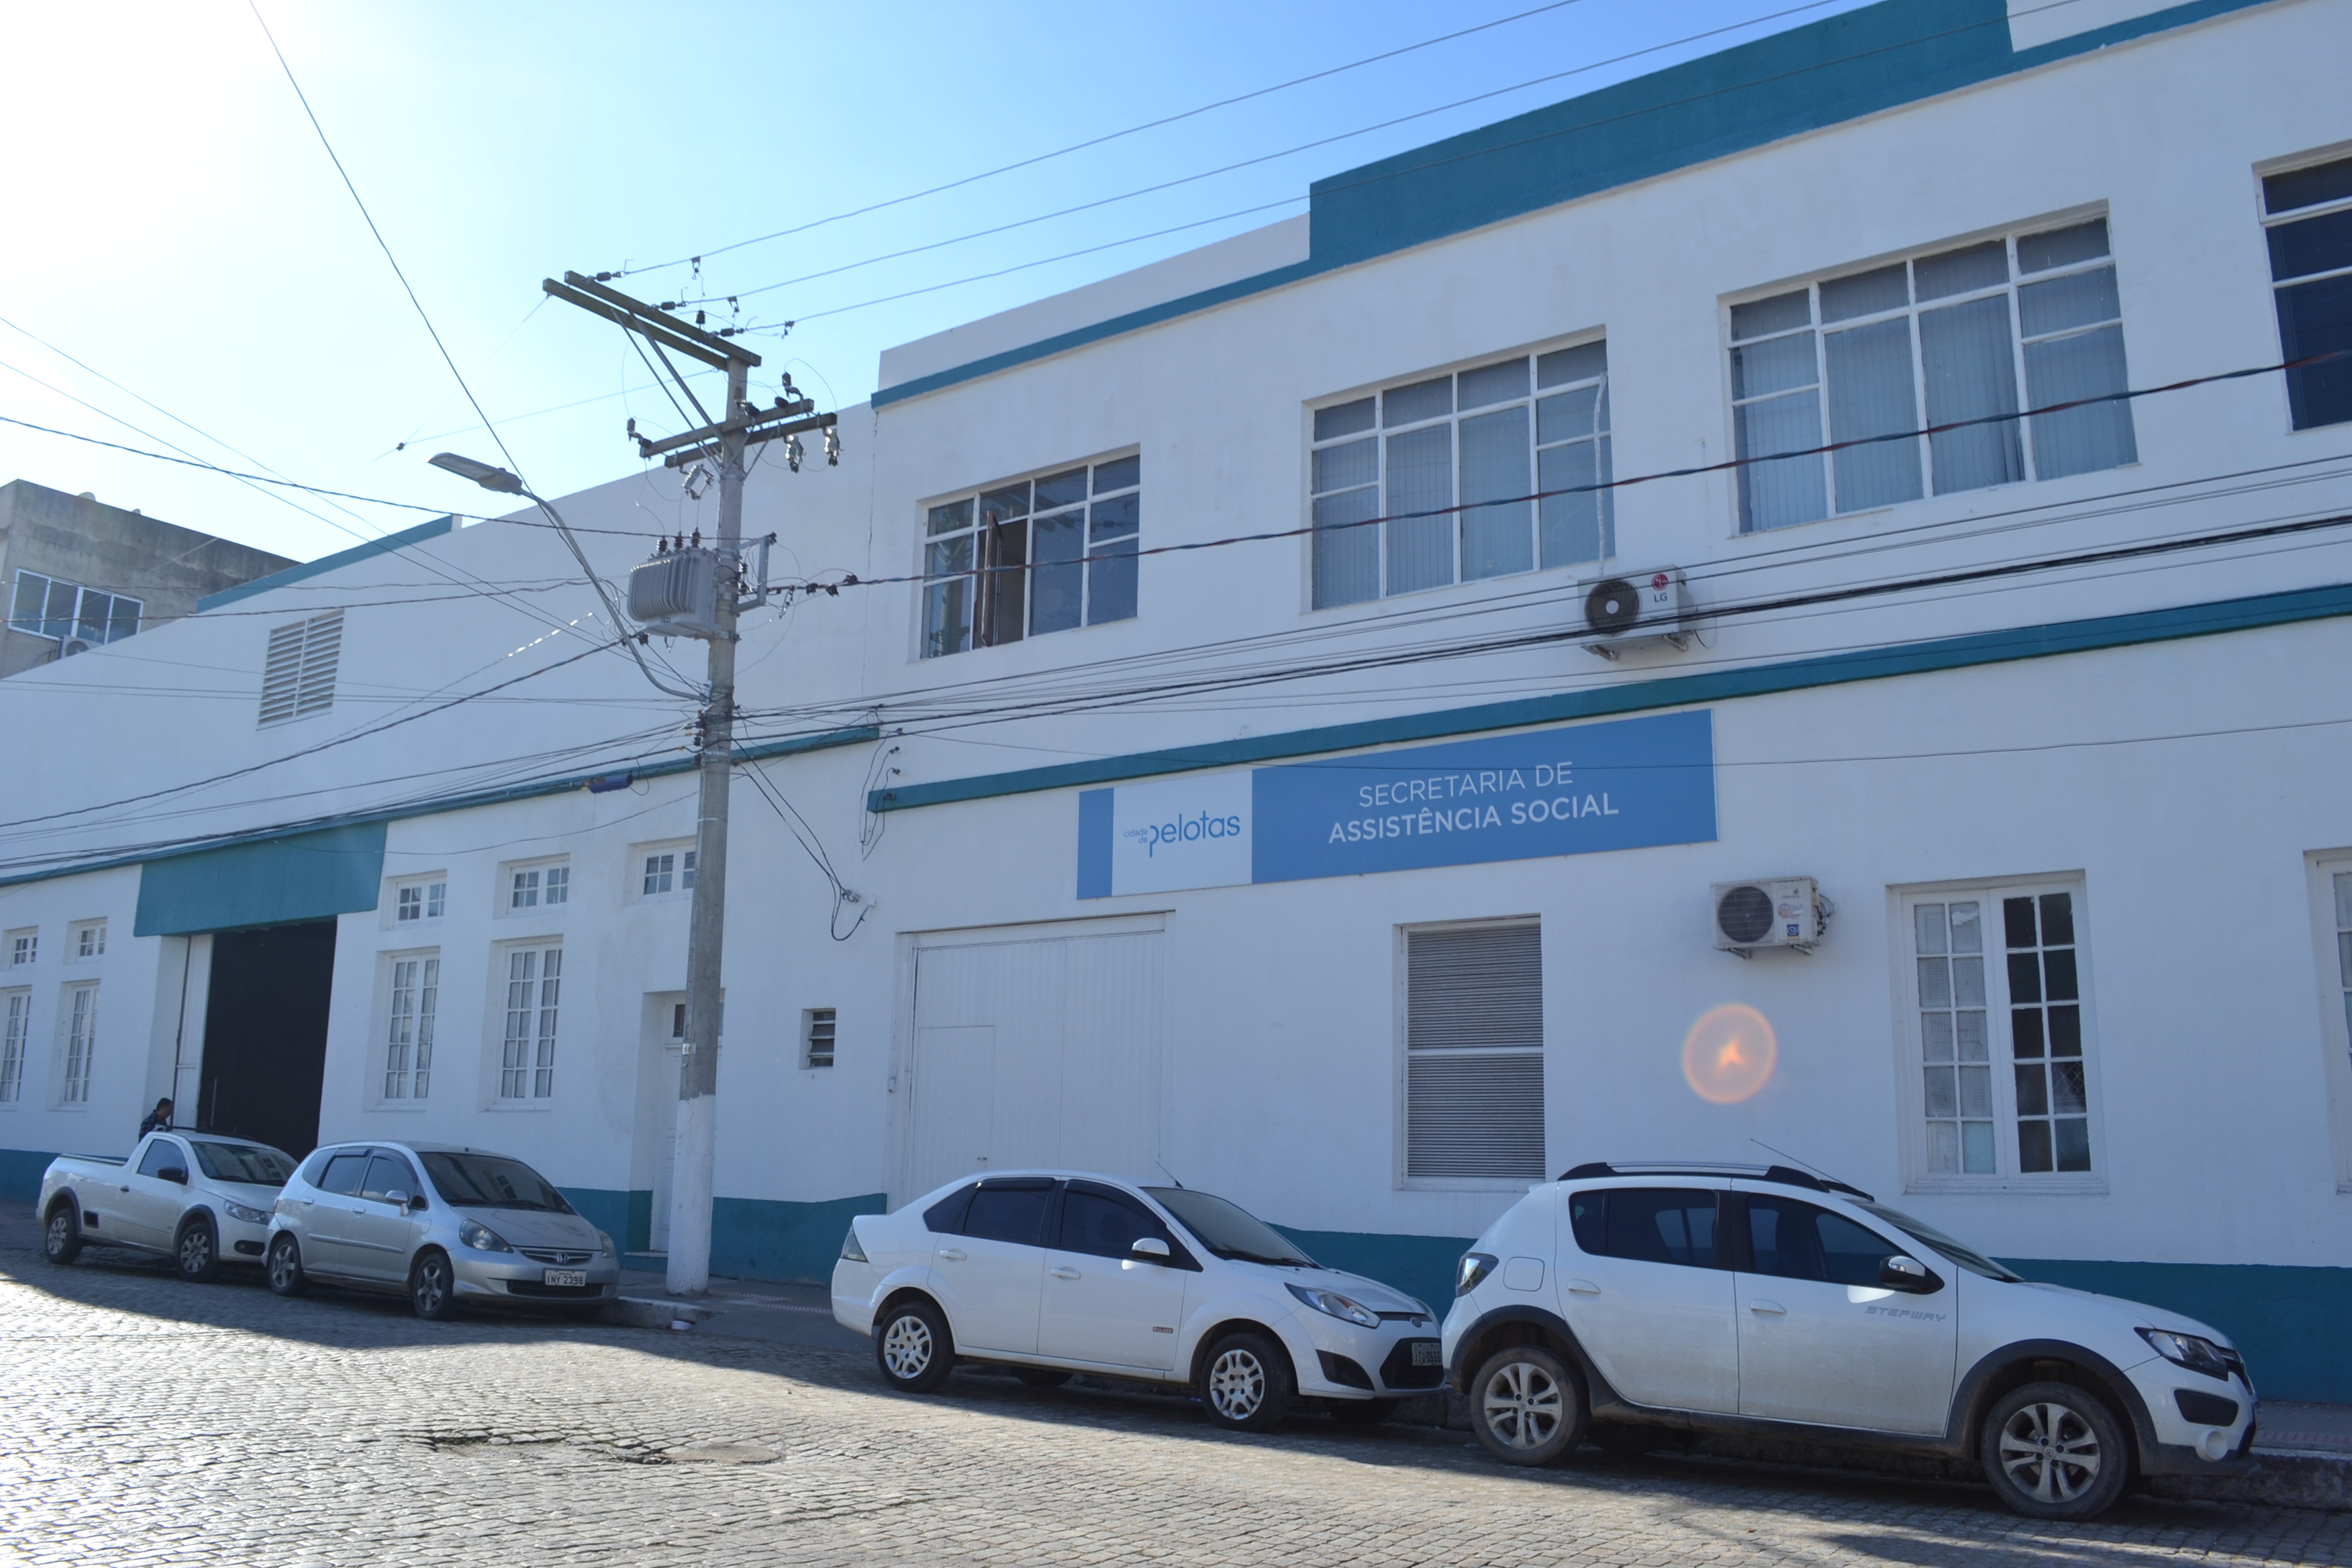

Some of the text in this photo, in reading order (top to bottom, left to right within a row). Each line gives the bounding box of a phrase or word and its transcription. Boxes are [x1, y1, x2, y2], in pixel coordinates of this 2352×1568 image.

[1654, 593, 1667, 603] LG
[1359, 761, 1573, 807] SECRETARIA DE
[1123, 828, 1148, 838] cidade
[1328, 792, 1619, 844] ASSISTÊNCIA SOCIAL
[1149, 811, 1241, 858] pelotas
[1865, 1305, 1946, 1322] STEPWAY
